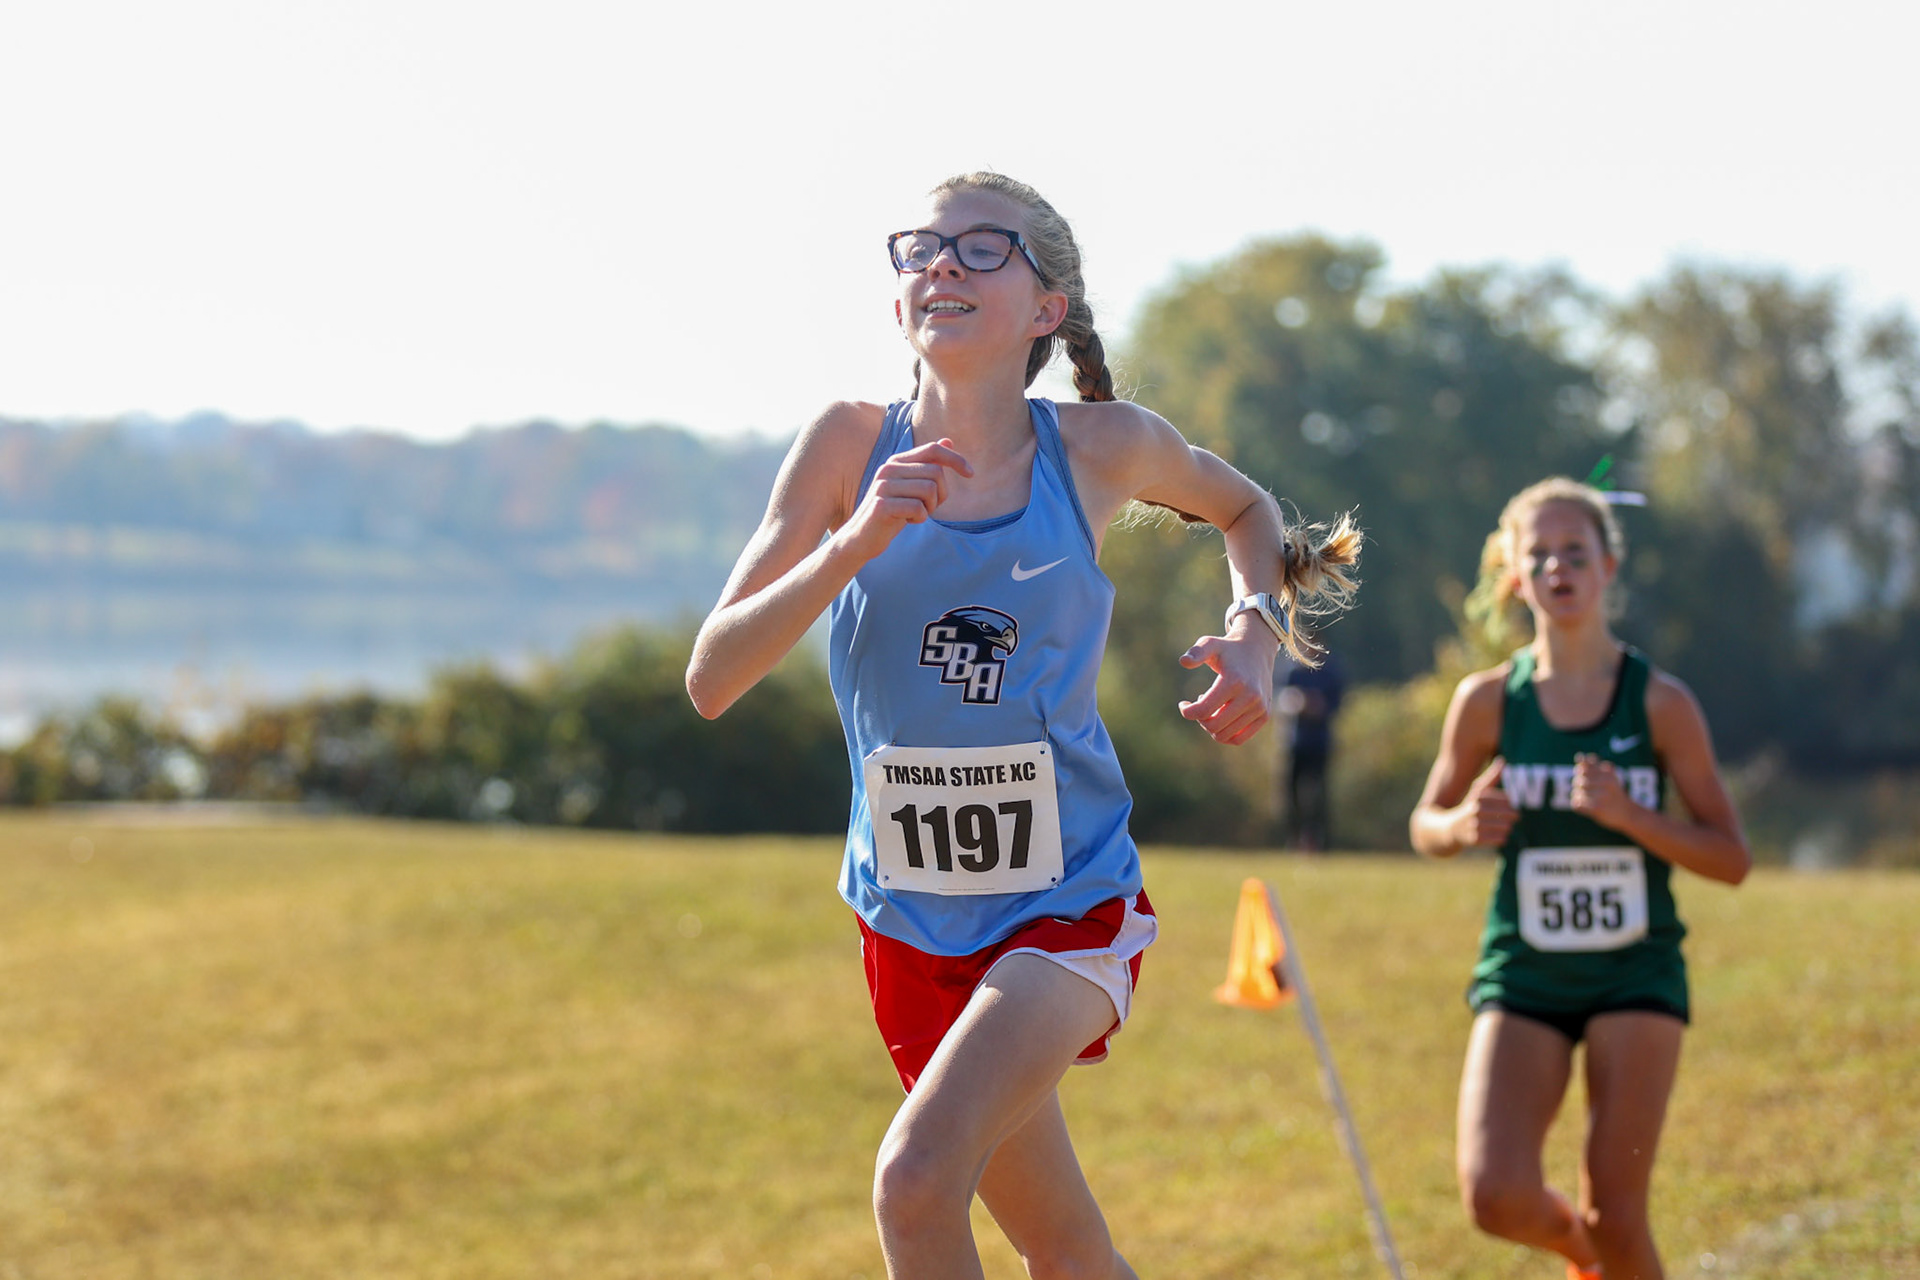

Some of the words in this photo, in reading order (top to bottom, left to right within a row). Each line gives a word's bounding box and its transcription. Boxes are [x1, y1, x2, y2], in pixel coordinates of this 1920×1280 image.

[923, 625, 1002, 701] SBA
[882, 764, 947, 786] TMSAA
[950, 764, 1007, 787] STATE
[1010, 761, 1036, 782] XC
[1502, 763, 1659, 810] WEB
[890, 799, 1033, 873] 1197
[1538, 886, 1624, 933] 585
